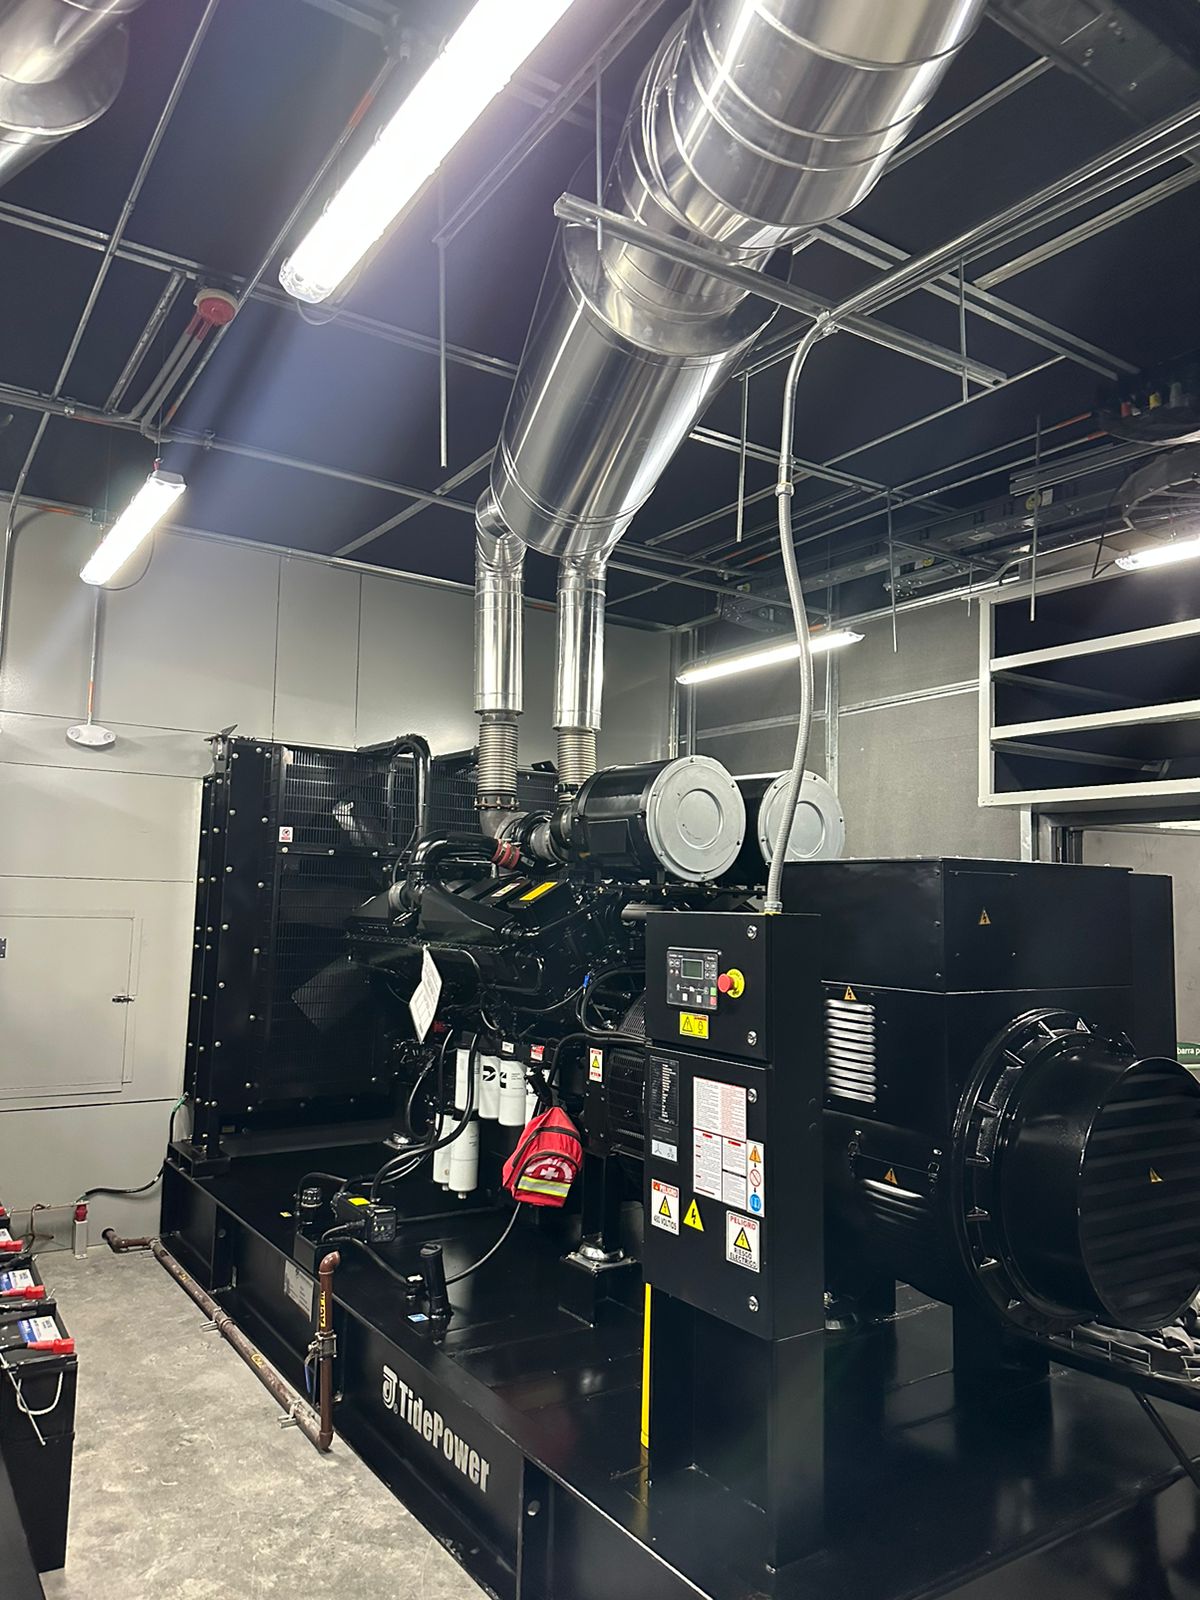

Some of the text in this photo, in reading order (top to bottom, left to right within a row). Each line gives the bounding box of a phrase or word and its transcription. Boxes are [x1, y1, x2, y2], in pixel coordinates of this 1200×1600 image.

[730, 1216, 756, 1231] PELIGRO
[730, 1252, 758, 1268] ELECTRICO
[734, 1247, 752, 1260] RIESGO
[398, 1380, 491, 1493] TidePower
